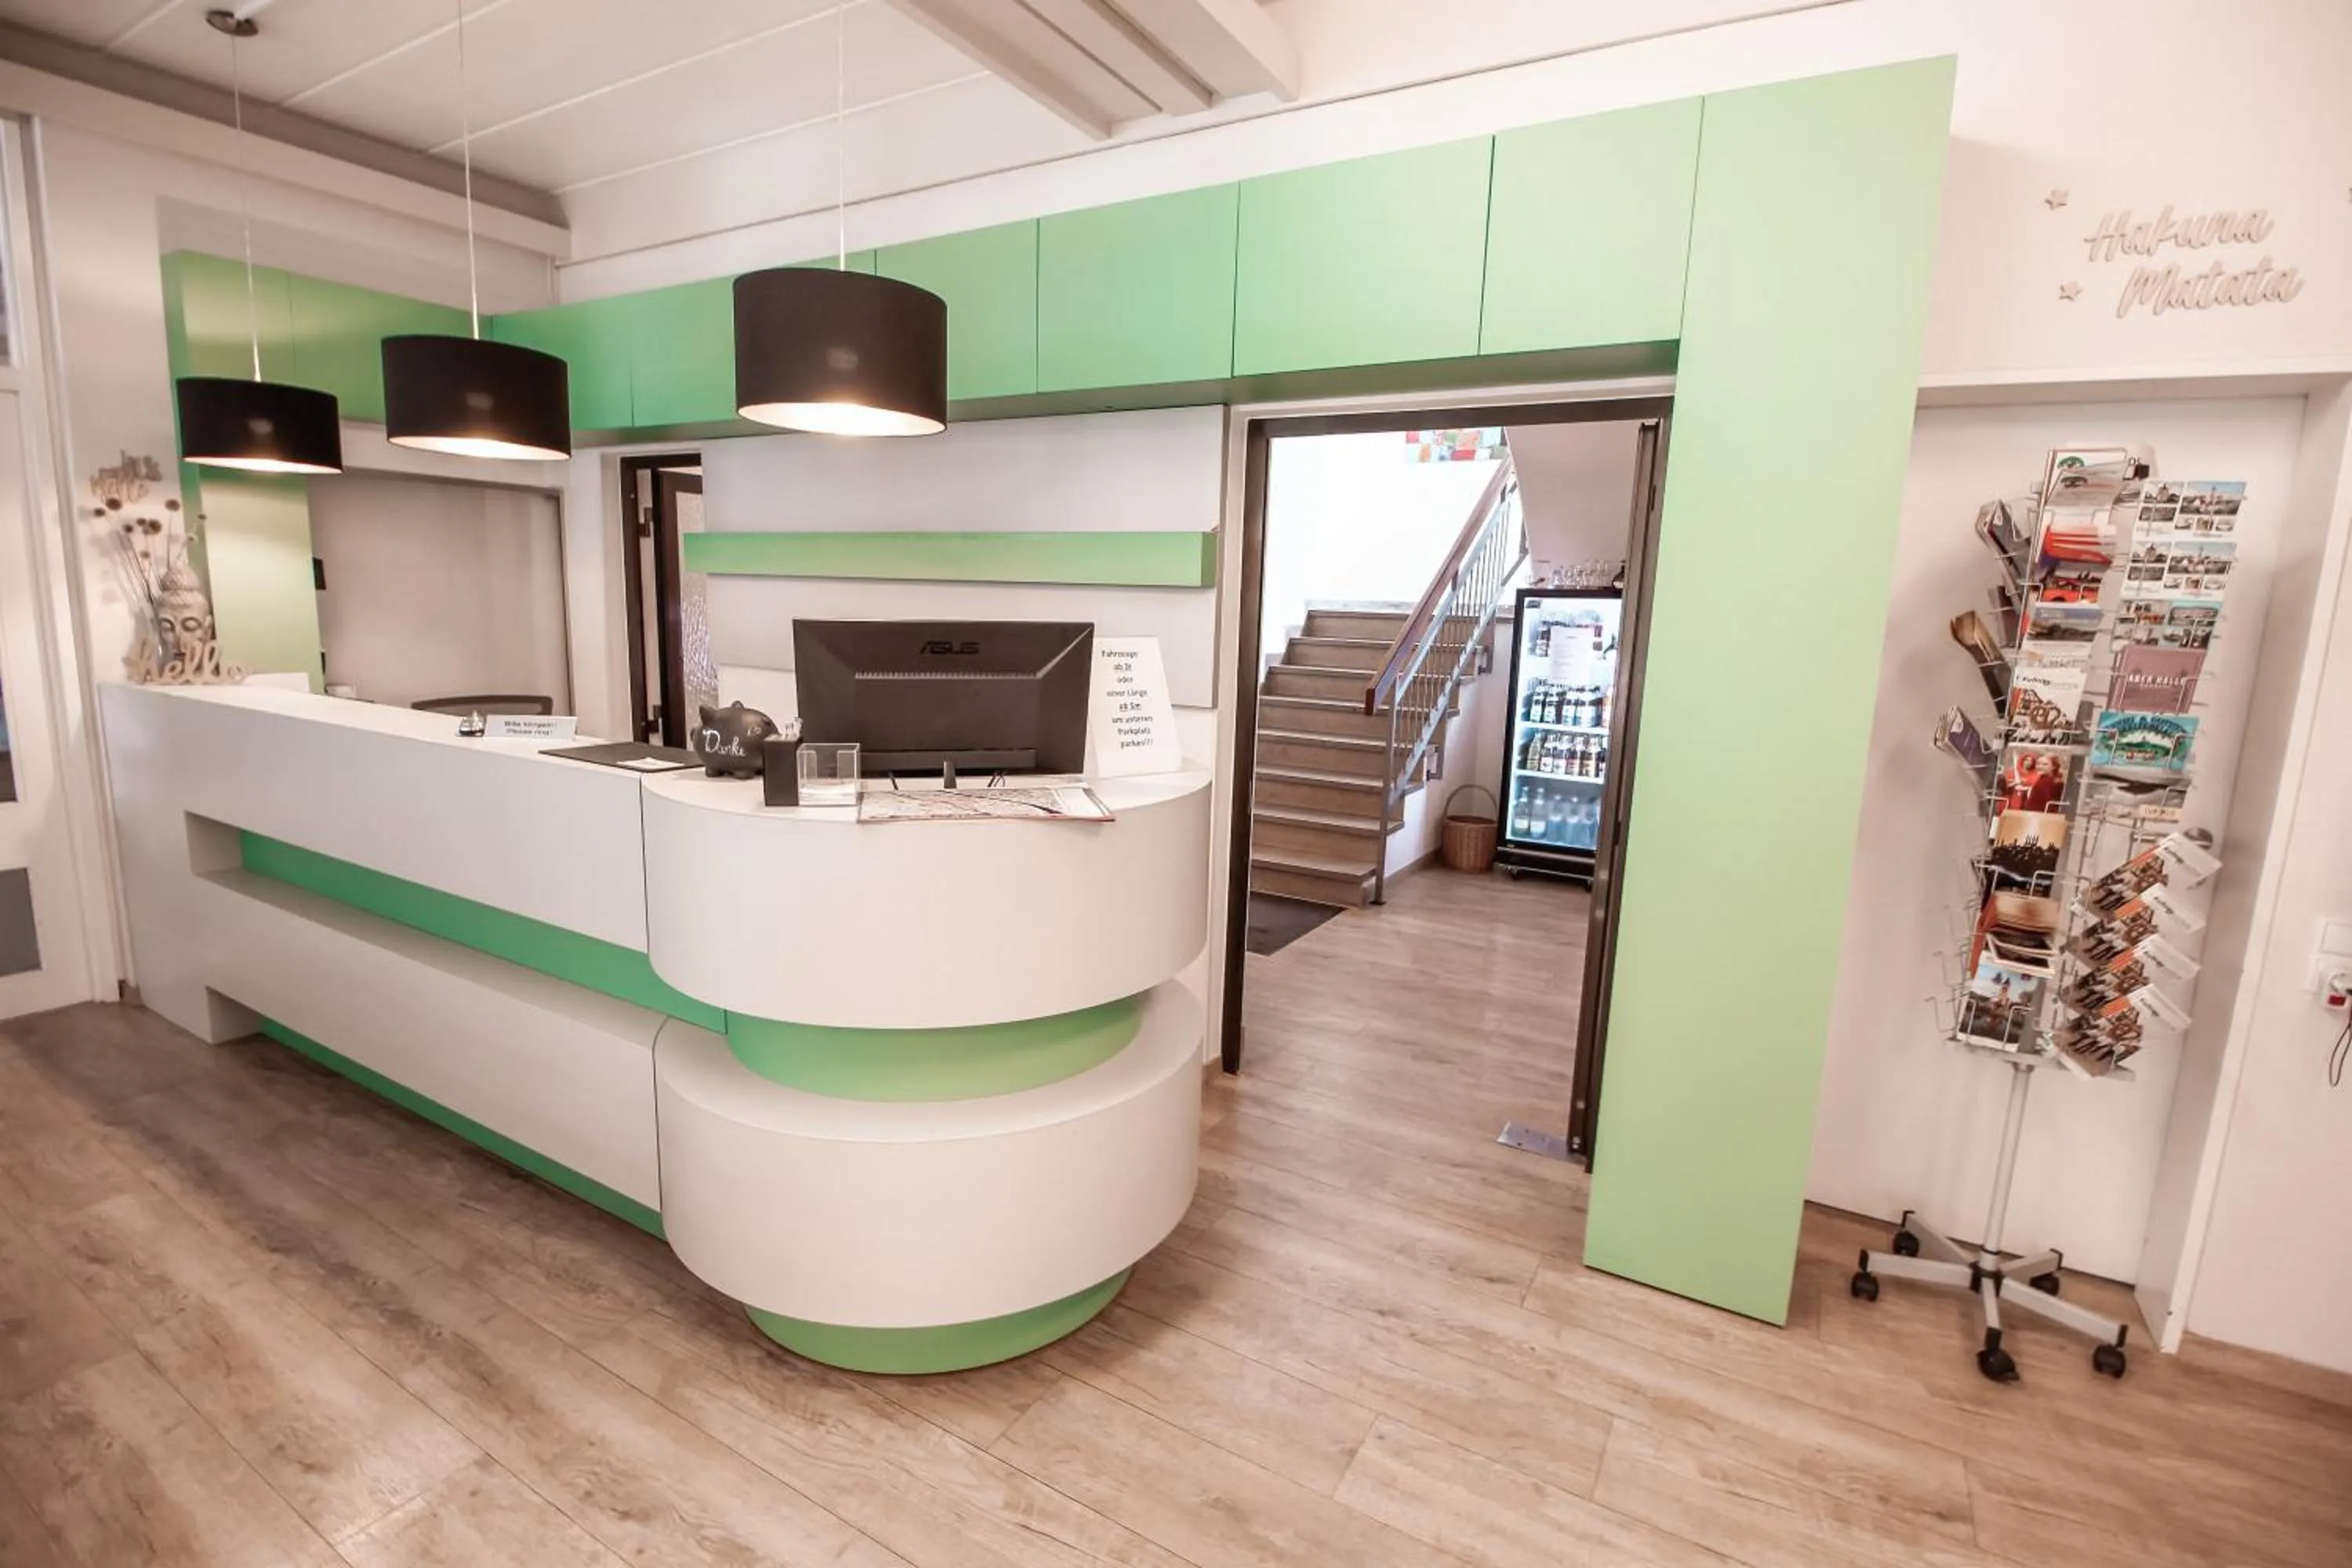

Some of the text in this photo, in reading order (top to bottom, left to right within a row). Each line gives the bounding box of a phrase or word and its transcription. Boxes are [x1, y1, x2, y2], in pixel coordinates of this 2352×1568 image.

[2083, 205, 2274, 263] Hakuna
[2116, 256, 2306, 320] Matata
[919, 641, 980, 655] ASUS
[702, 728, 746, 757] Danke
